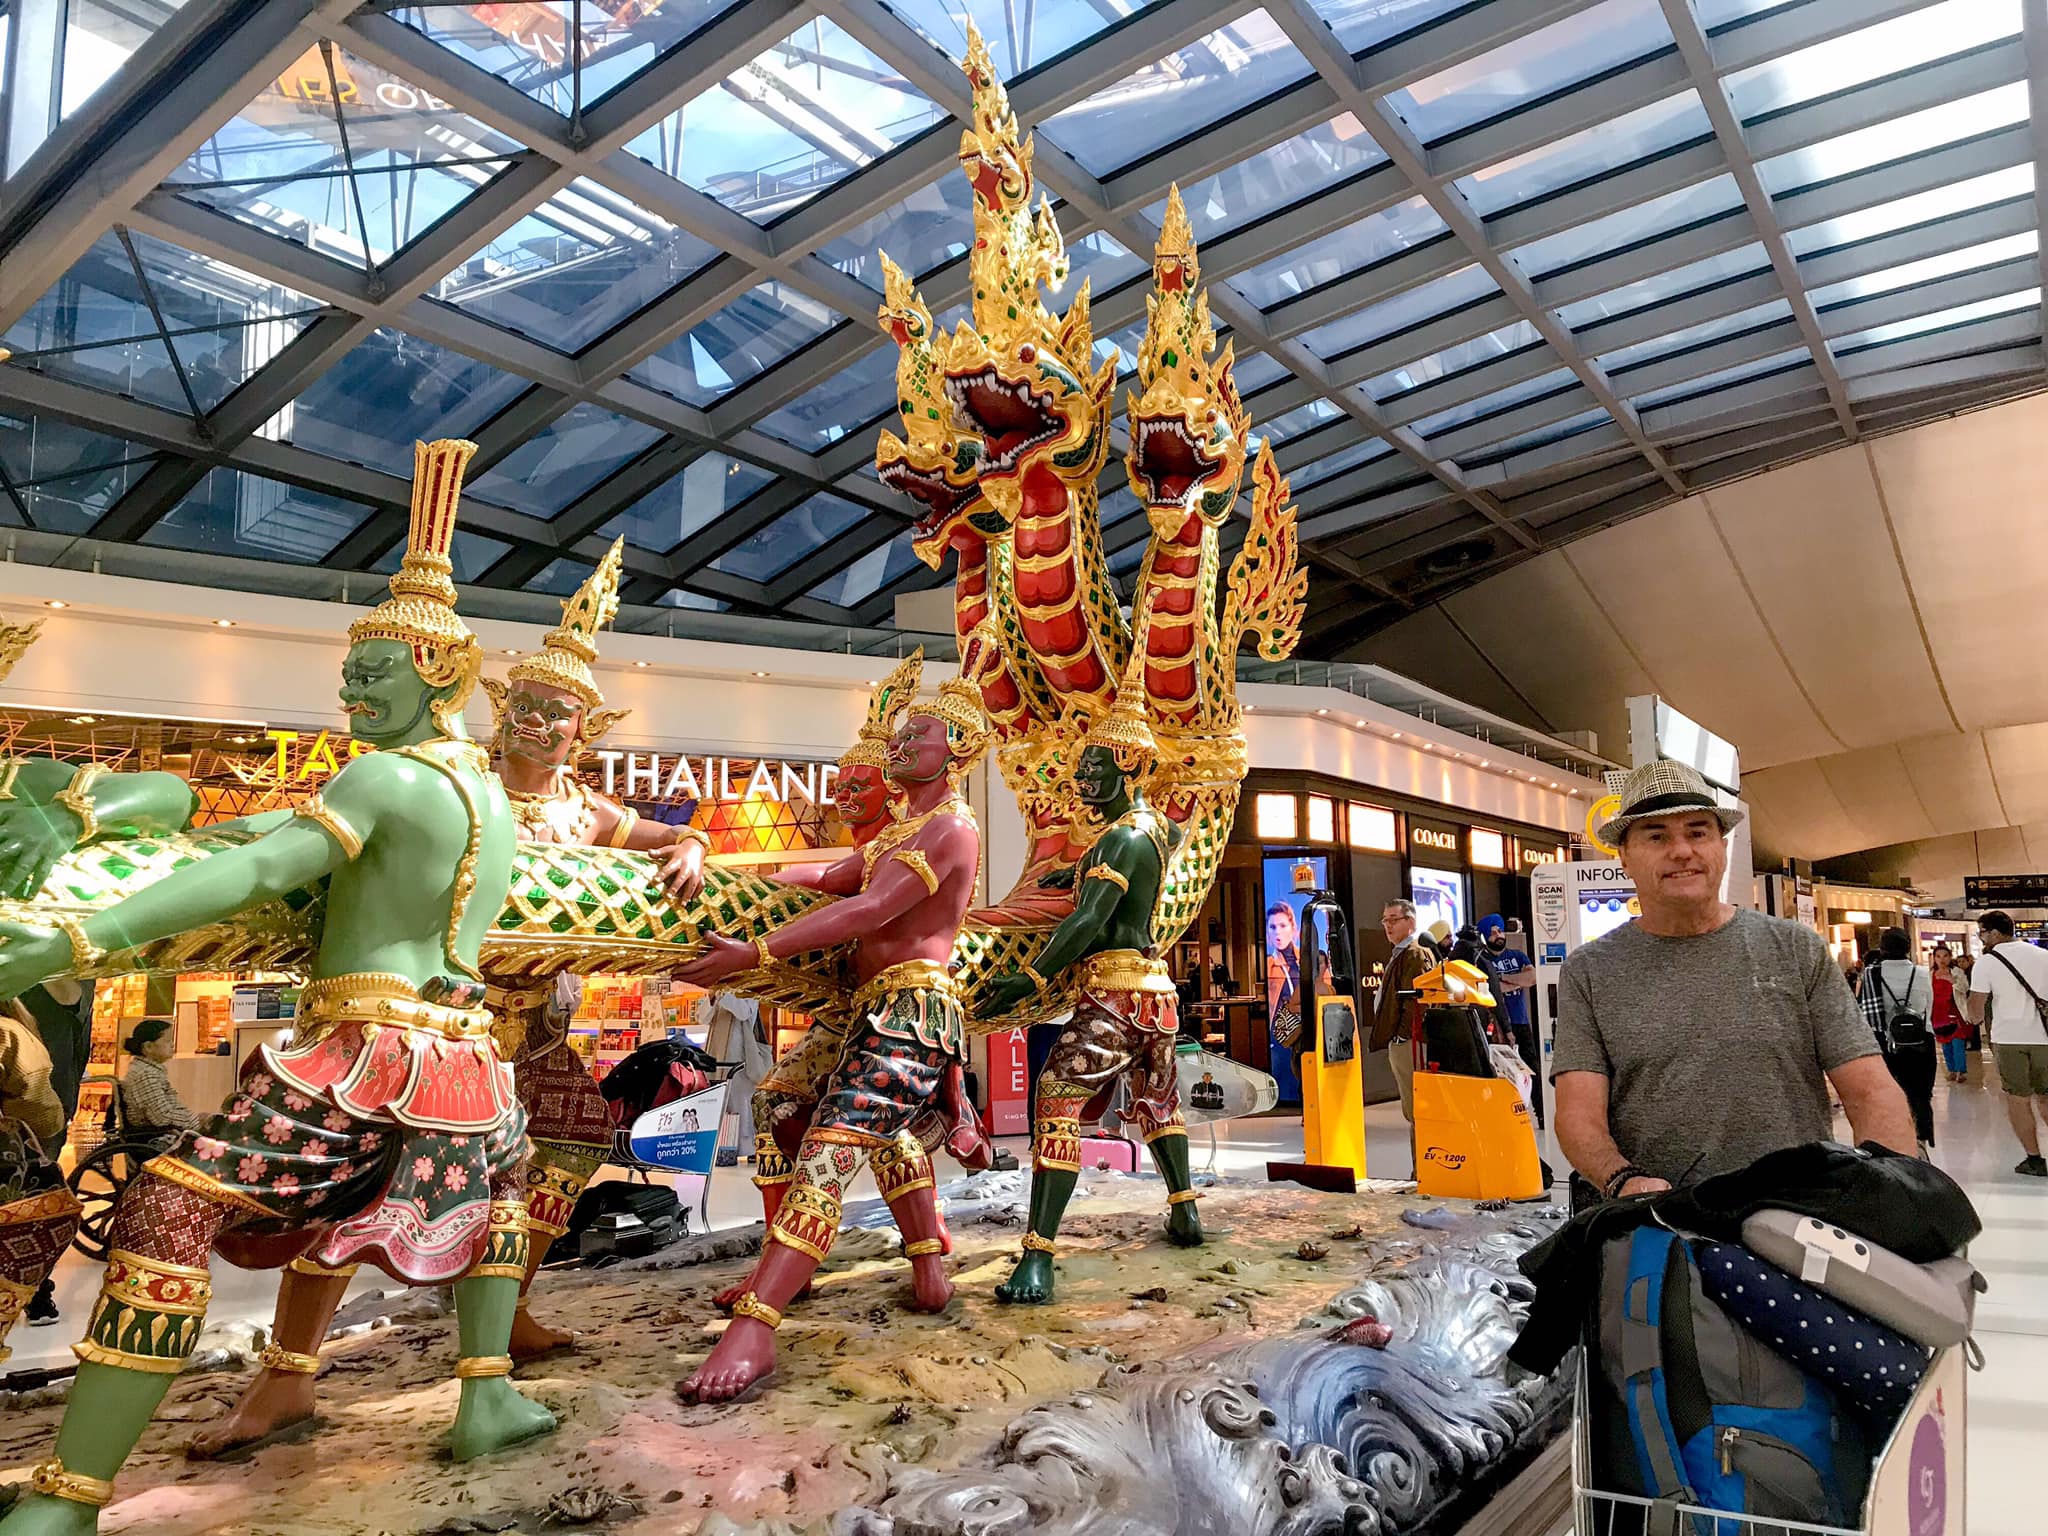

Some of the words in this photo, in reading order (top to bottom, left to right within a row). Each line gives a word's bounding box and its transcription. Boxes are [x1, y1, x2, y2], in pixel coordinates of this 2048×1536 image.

[1413, 827, 1456, 850] COACH
[1576, 867, 1629, 882] INFOR
[1538, 886, 1563, 894] SCAN
[681, 1145, 697, 1156] 20%
